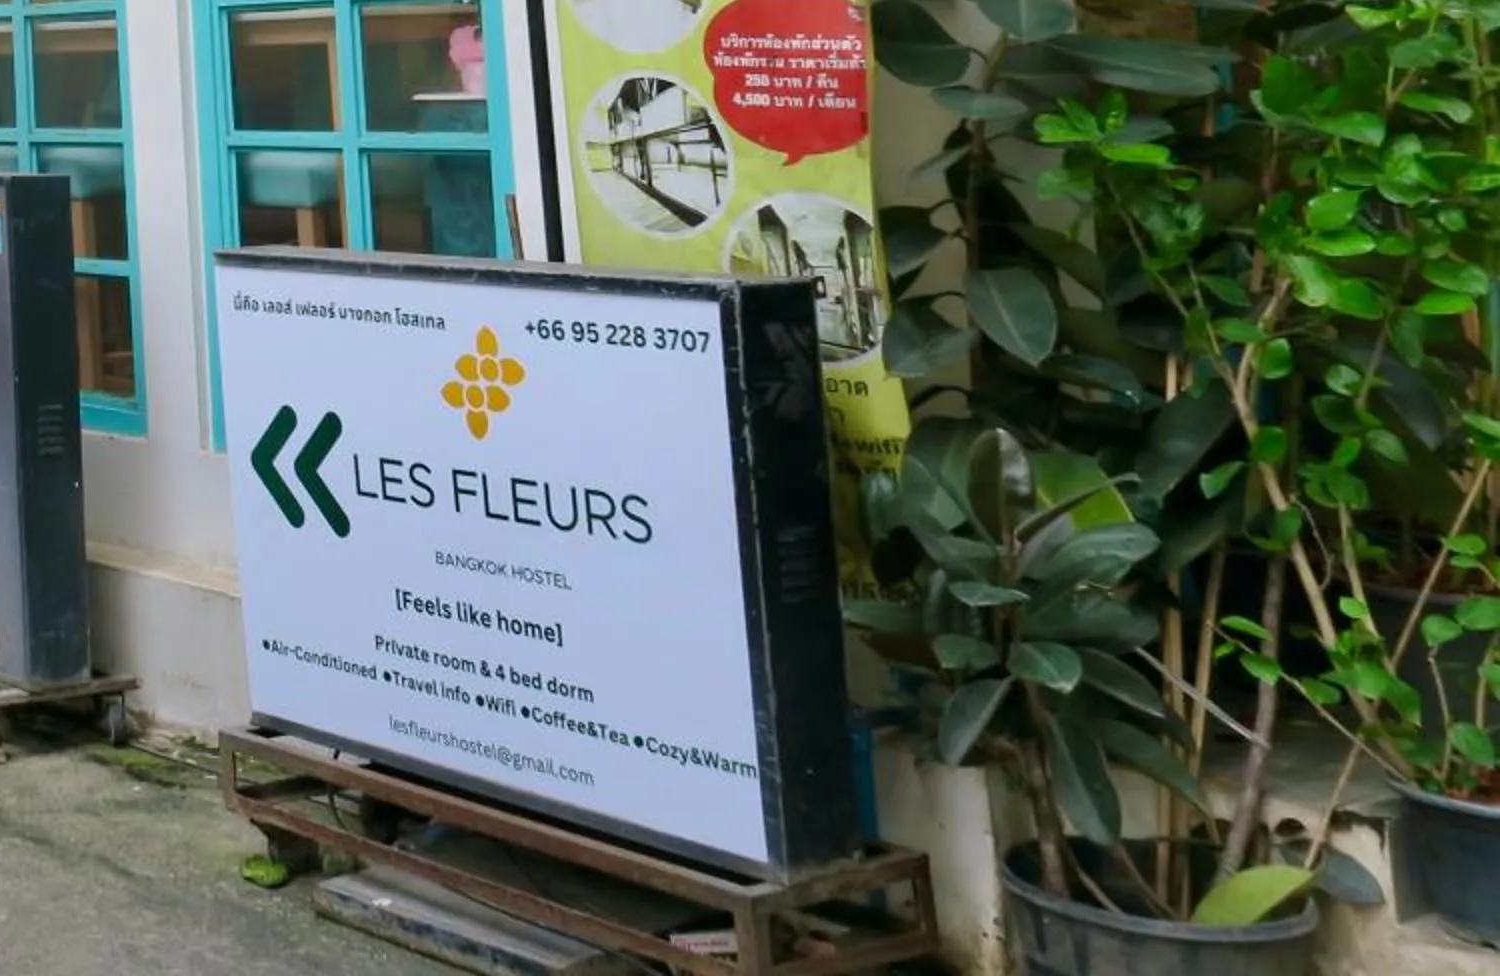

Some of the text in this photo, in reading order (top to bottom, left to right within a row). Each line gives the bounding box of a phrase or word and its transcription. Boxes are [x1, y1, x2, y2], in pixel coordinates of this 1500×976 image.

[524, 318, 711, 354] +66 95 228 3707
[352, 452, 654, 545] LES FLEURS
[434, 550, 574, 591] BANGKOK HOSTEL
[394, 588, 565, 648] [Feels like home]
[374, 634, 596, 705] Private room & 4 bed dorm
